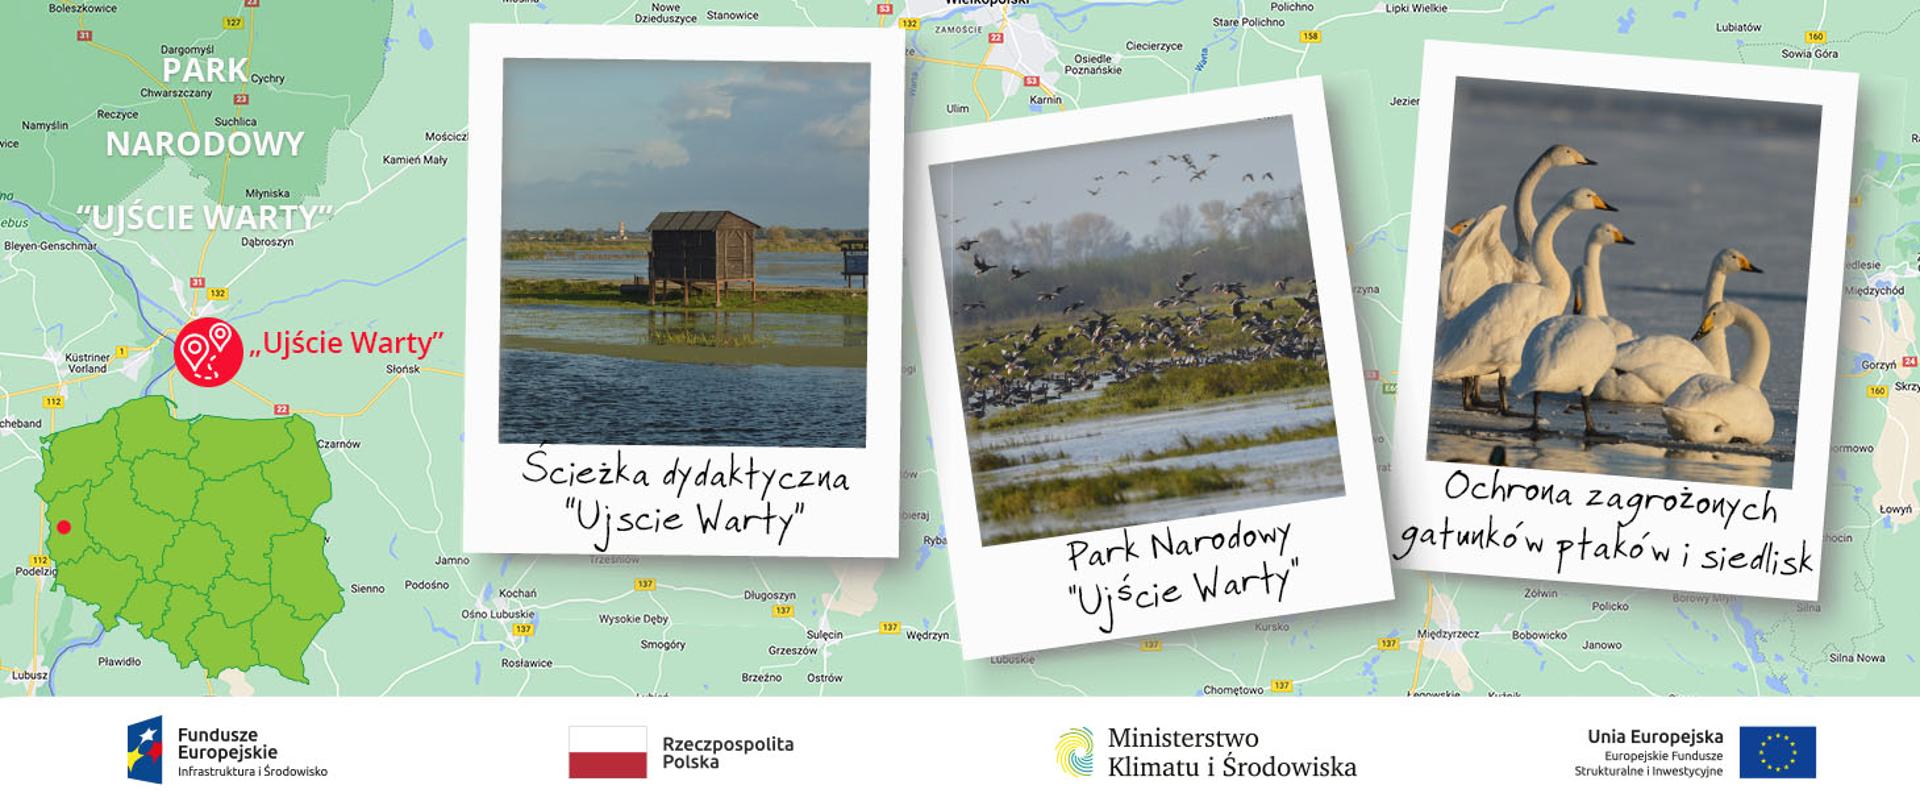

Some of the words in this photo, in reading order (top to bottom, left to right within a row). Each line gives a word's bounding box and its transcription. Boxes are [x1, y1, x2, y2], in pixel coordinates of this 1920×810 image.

[49, 3, 117, 13] Boleszkowice
[652, 3, 681, 12] Nowe
[879, 5, 890, 13] S3
[1271, 2, 1314, 12] Polichno
[1386, 3, 1409, 14] Lipki
[1412, 3, 1448, 13] Wielkie
[635, 14, 697, 24] Dzieduszyce
[706, 10, 759, 20] Stanowice
[226, 18, 241, 27] 127
[902, 19, 917, 28] 132
[1213, 17, 1239, 27] Stare
[1242, 17, 1285, 27] Polichno
[1716, 22, 1761, 32] Lubiatów
[935, 25, 983, 34] ZAMOŚCIE
[79, 32, 90, 40] 31
[991, 34, 1001, 42] 22
[1304, 32, 1318, 40] 158
[1809, 33, 1823, 41] 160
[161, 44, 214, 56] Dargomyśl
[1126, 40, 1183, 52] Ciecierzyce
[1195, 47, 1208, 71] Warta
[1782, 49, 1811, 59] Sowia
[1814, 48, 1839, 59] Góra
[1074, 54, 1112, 65] Osiedle
[163, 57, 248, 83] PARK
[1065, 64, 1122, 76] Poznańskie
[251, 73, 285, 86] Cychry
[140, 88, 213, 100] Chwarszczany
[236, 95, 247, 104] 23
[1030, 95, 1062, 105] Karnin
[97, 109, 138, 120] Reczyce
[946, 104, 969, 114] Ulim
[22, 120, 68, 132] Namyślin
[215, 117, 257, 127] Suchlica
[107, 131, 304, 156] NARODOWY
[383, 154, 420, 165] Kamień
[424, 154, 447, 167] Mały
[245, 188, 290, 200] Młyniska
[77, 200, 200, 236] “UJŚCIE
[204, 204, 333, 231] WARTY”
[4, 241, 97, 252] Bleyen-Genschmar
[241, 236, 294, 250] Dąbroszyn
[210, 289, 225, 298] 132
[1845, 285, 1904, 297] Międzychód
[249, 330, 343, 358] „Ujście
[351, 331, 444, 358] Warty”
[65, 352, 110, 363] Küstriner
[1904, 358, 1916, 366] 24
[68, 363, 107, 373] Vorland
[386, 364, 420, 374] Słońsk
[1862, 360, 1896, 371] Gorzyń
[1871, 387, 1885, 395] 160
[276, 405, 288, 414] 22
[317, 440, 361, 449] Czarnów
[522, 440, 650, 487] Ścieżka
[662, 452, 850, 500] dydaktyczna
[1445, 469, 1572, 506] Ochrona
[1586, 486, 1778, 531] zagrożonych
[1880, 504, 1912, 515] Łowyń
[565, 496, 684, 552] "Ujscie
[697, 499, 805, 546] Warty"
[1066, 528, 1139, 571] Park
[1151, 519, 1291, 556] Narodowy
[1392, 514, 1543, 561] gatunków
[1557, 520, 1670, 573] ptaków
[1682, 543, 1691, 567] i
[1701, 539, 1814, 576] siedlisk
[33, 556, 48, 564] 112
[435, 556, 470, 566] Jamno
[16, 567, 57, 578] Podelzig
[351, 584, 385, 594] Sienno
[405, 579, 449, 591] Podośno
[638, 580, 653, 588] 137
[500, 588, 537, 599] Kochań
[744, 590, 796, 603] Długoszyn
[1069, 573, 1182, 633] "Ujście
[1193, 556, 1299, 602] Warty"
[776, 607, 791, 615] 137
[1592, 601, 1629, 612] Policko
[1796, 602, 1822, 613] Silna
[461, 609, 488, 619] Ośno
[491, 609, 535, 619] Lubuskie
[600, 614, 639, 626] Wysokie
[641, 614, 669, 627] Dęby
[516, 625, 531, 634] 137
[883, 623, 898, 632] 137
[1255, 621, 1289, 632] Kursko
[807, 629, 843, 641] Sulęcin
[906, 630, 949, 643] Wędrzyn
[1417, 629, 1480, 640] Międzyrzecz
[1512, 629, 1567, 640] Bobowicko
[641, 639, 686, 652] Smogóry
[1382, 639, 1397, 648] 137
[1582, 639, 1622, 650] Janowo
[768, 645, 818, 657] Grzeszów
[98, 657, 141, 667] Pławidło
[502, 658, 553, 668] Rosławice
[990, 655, 1035, 664] Lubuskie
[1829, 652, 1854, 663] Silna
[1857, 652, 1886, 663] Nowa
[12, 671, 48, 680] Lubusz
[742, 672, 782, 683] Brzeźno
[807, 672, 843, 683] Ostrów
[1203, 685, 1264, 696] Chomętowo
[1274, 681, 1289, 690] 137
[178, 728, 258, 742] Fundusze
[1108, 727, 1259, 749] Ministerstwo
[1588, 729, 1626, 744] Unia
[1631, 728, 1724, 747] Europejska
[663, 736, 795, 757] Rzeczpospolita
[178, 744, 278, 763] Europejskie
[1605, 751, 1669, 763] Europejskie
[1672, 751, 1723, 761] Fundusze
[663, 754, 720, 770] Polska
[1108, 756, 1200, 778] Klimatu
[1208, 756, 1217, 778] i
[1222, 752, 1358, 778] Środowiska
[178, 766, 256, 777] Infrastruktura
[264, 764, 329, 777] Środowisko
[1575, 766, 1644, 777] Strukturalne
[1652, 766, 1723, 778] Inwestycyjne
